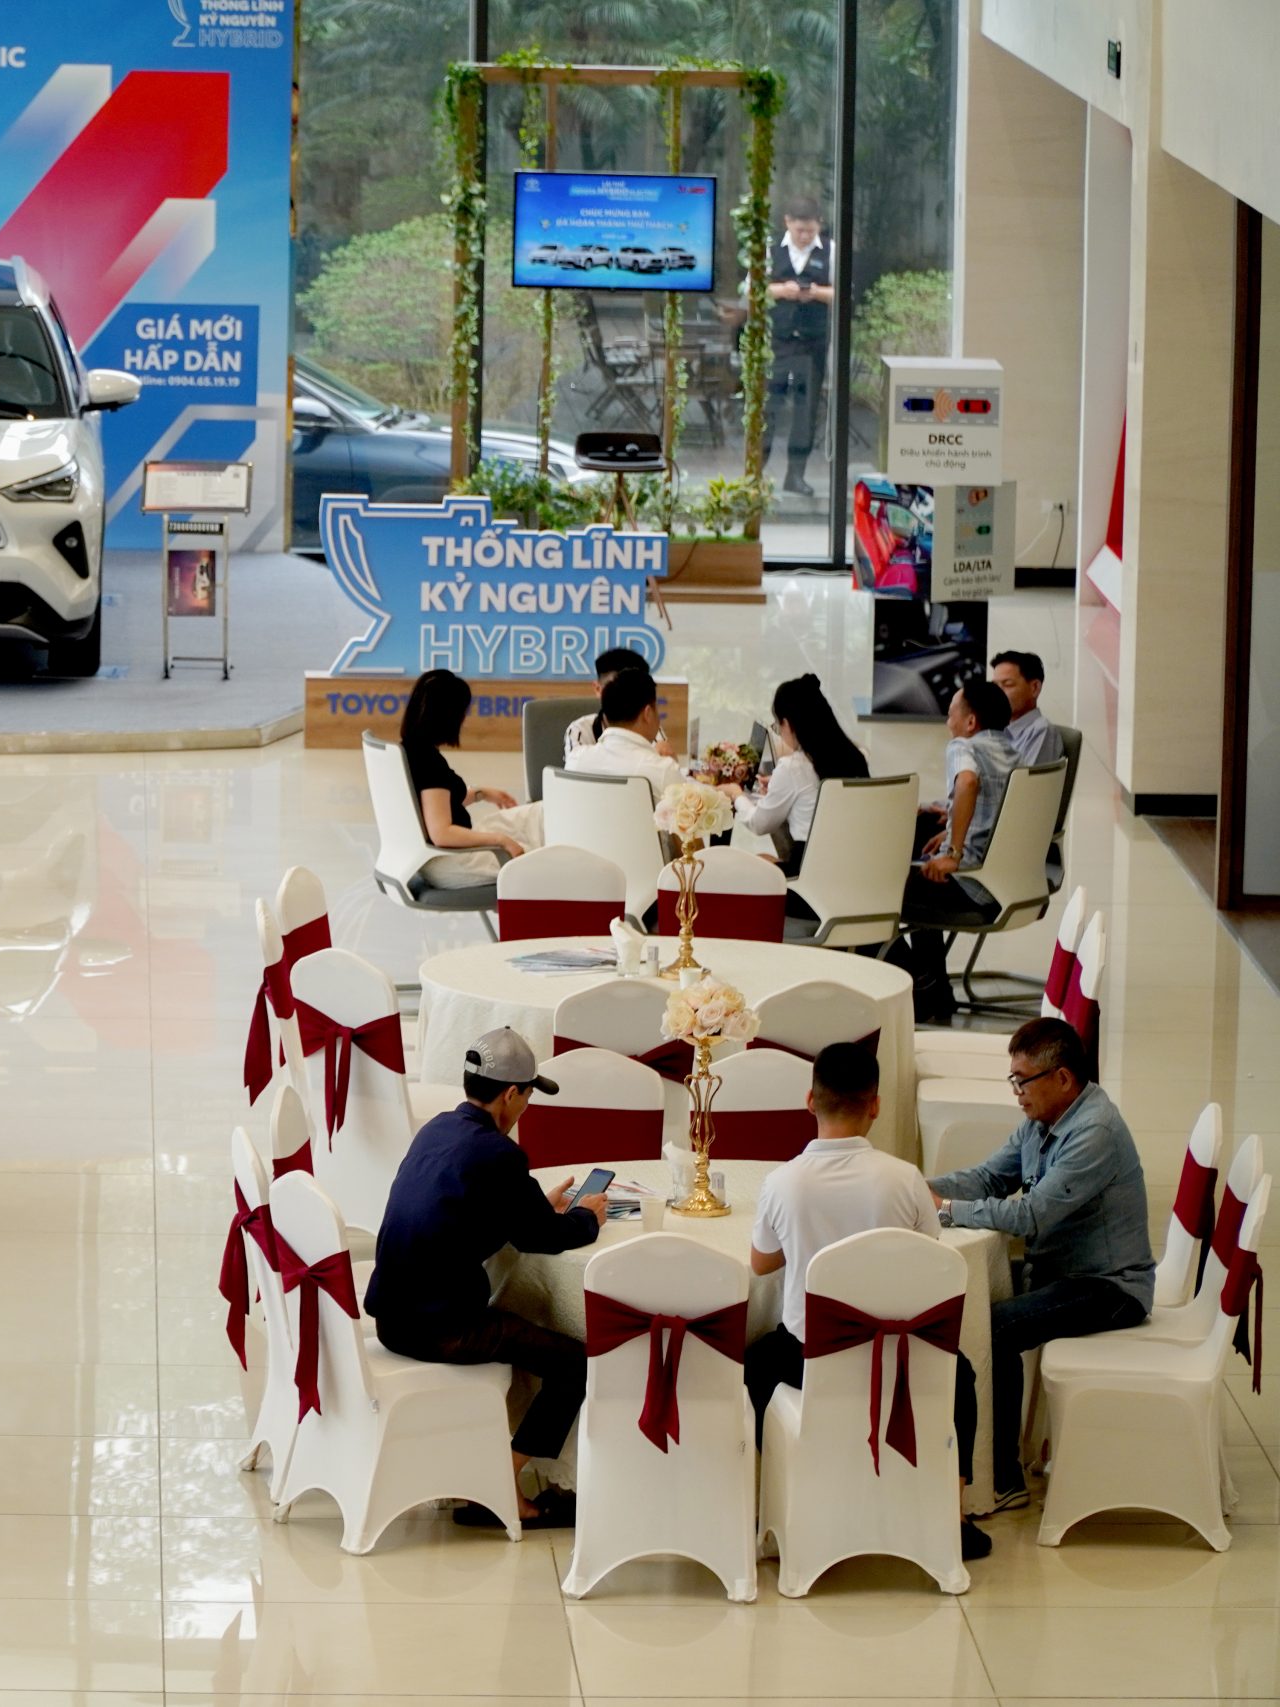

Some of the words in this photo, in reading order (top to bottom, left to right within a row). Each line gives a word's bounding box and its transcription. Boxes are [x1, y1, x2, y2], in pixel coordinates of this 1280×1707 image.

[198, 28, 284, 48] HYBRID
[135, 313, 184, 340] GIÁ
[189, 314, 243, 341] MỚI
[123, 344, 179, 371] HẤP
[184, 341, 242, 372] DẪN
[928, 434, 964, 445] DRCC
[422, 528, 563, 569] THỐNG
[573, 532, 662, 570] LĨNH
[953, 560, 992, 573] LDA/LTA
[421, 571, 472, 612] KỶ
[479, 575, 640, 614] NGUYÊN
[421, 624, 666, 675] HYBRID
